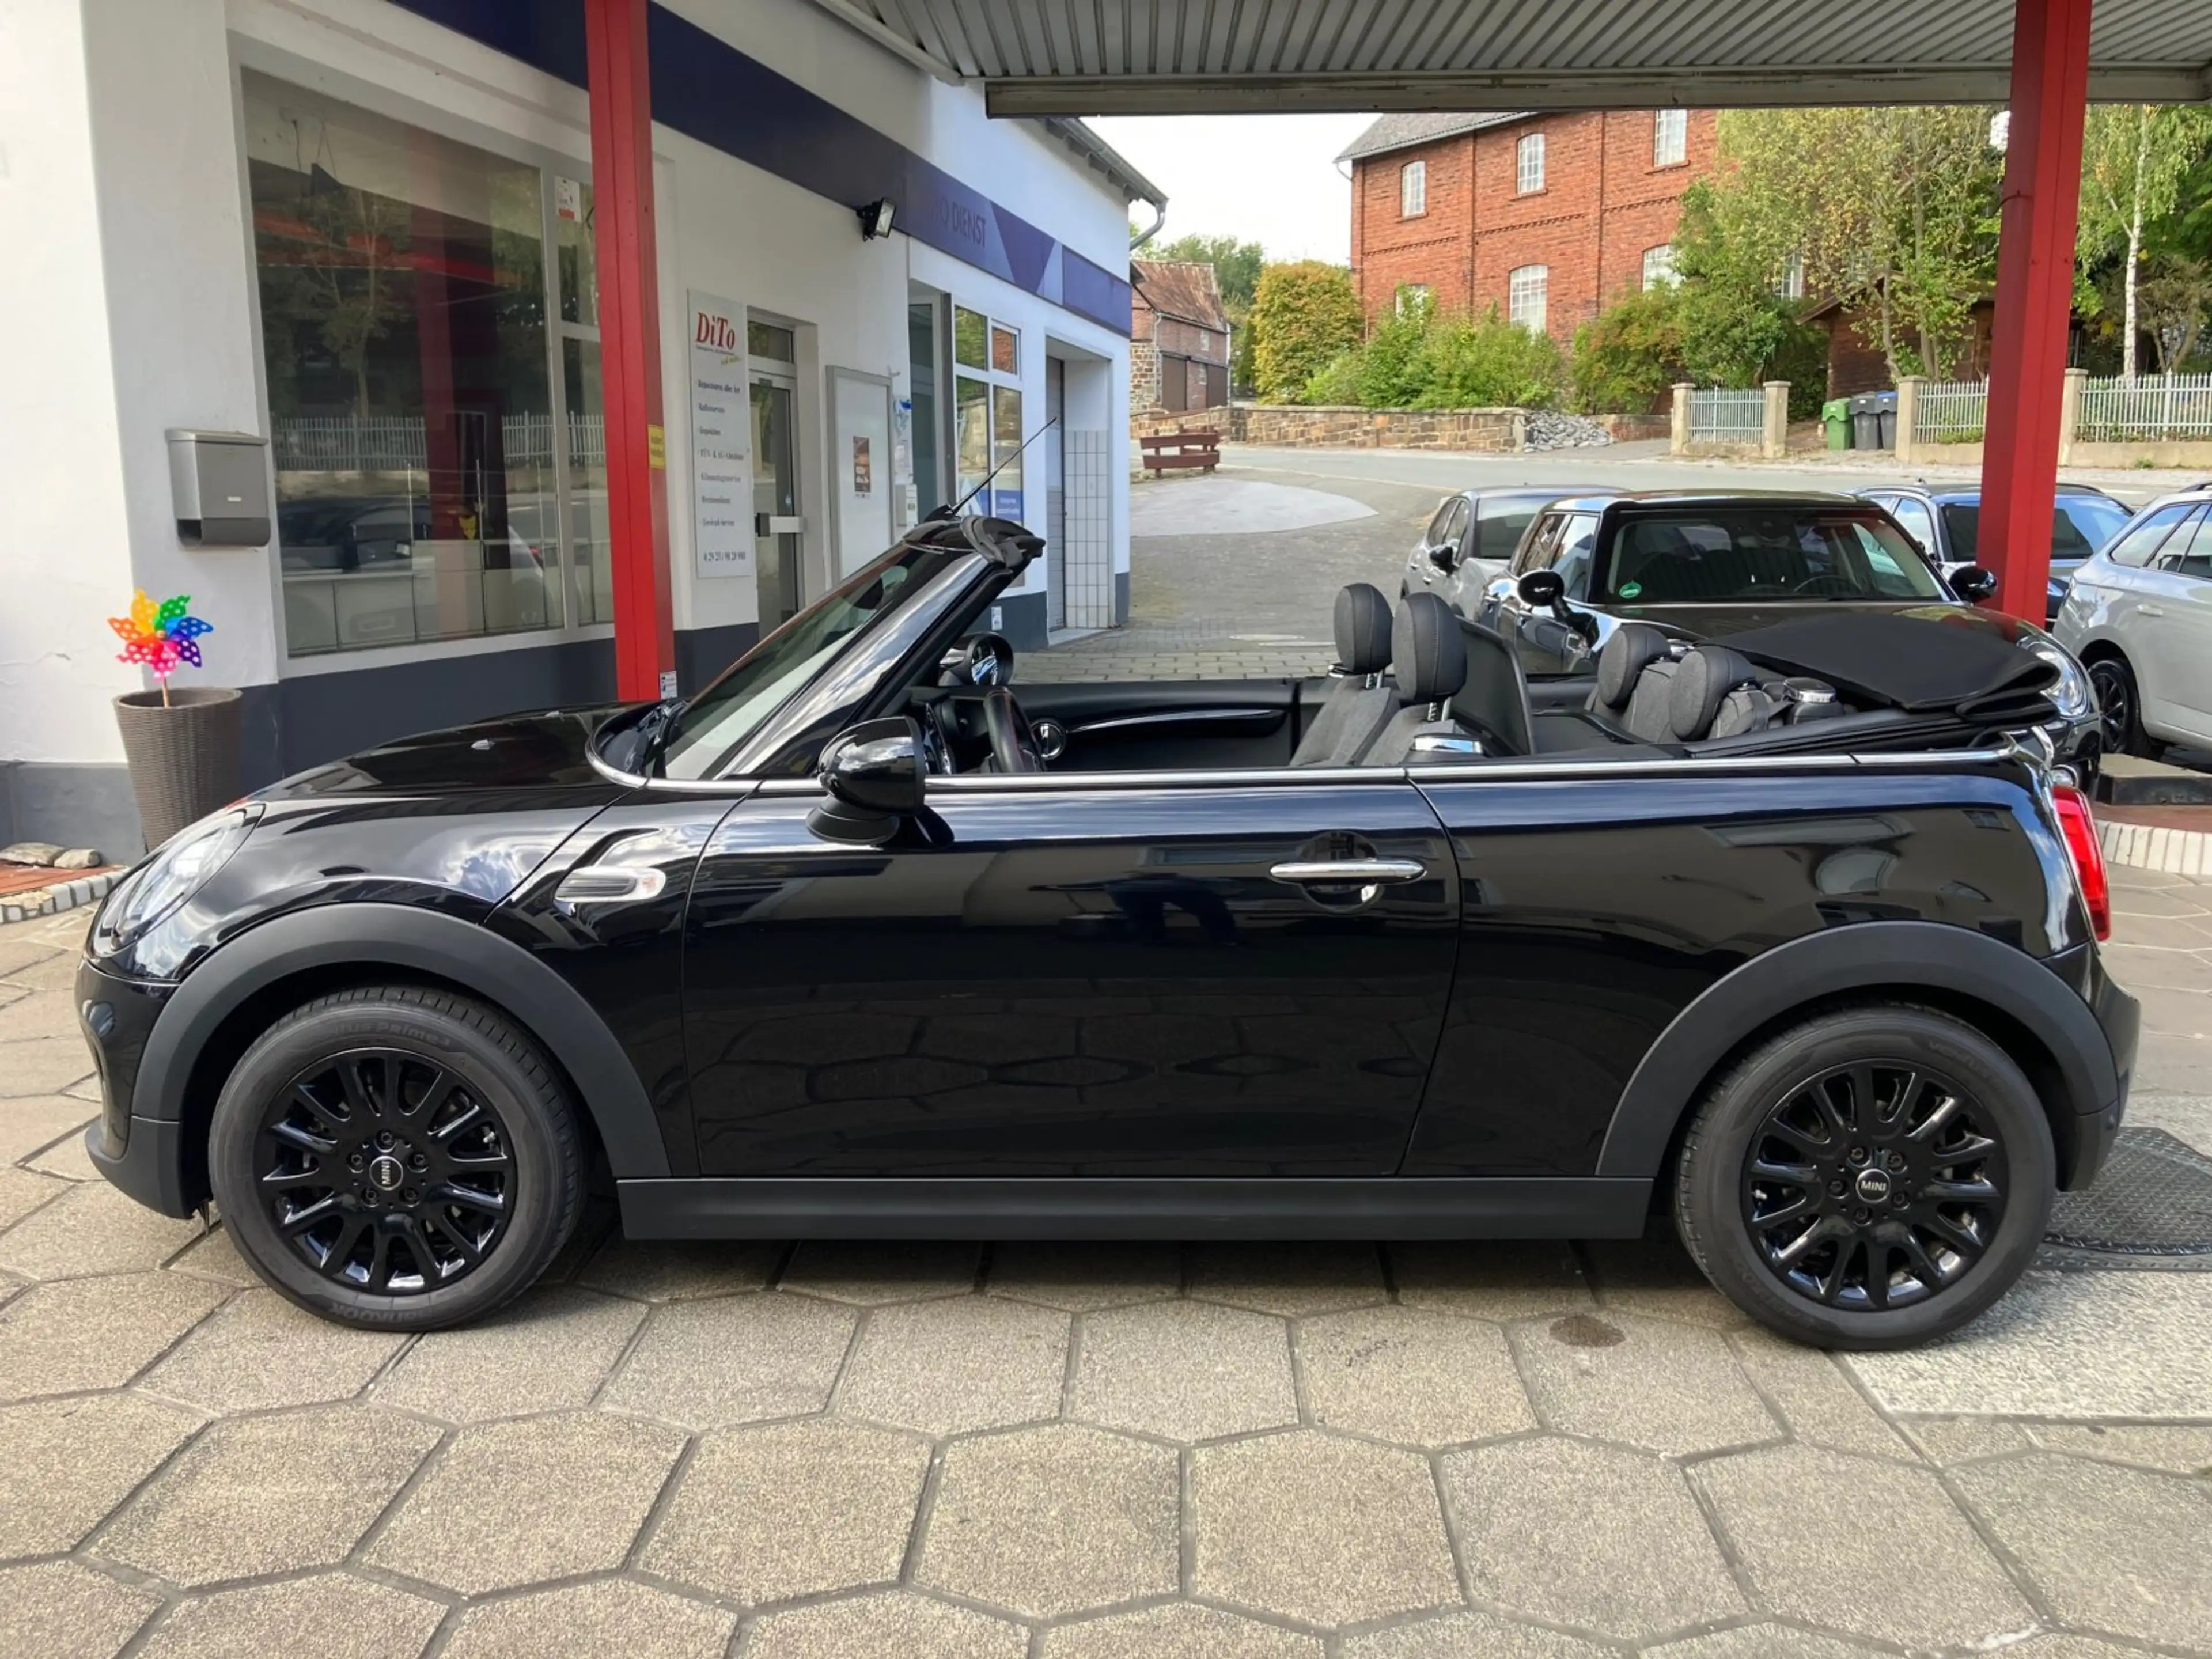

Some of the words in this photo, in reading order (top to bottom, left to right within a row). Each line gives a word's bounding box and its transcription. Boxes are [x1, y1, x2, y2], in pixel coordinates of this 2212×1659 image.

[952, 202, 987, 248] DIENST
[695, 311, 735, 350] DiTo
[381, 1161, 391, 1185] MINI
[1860, 1180, 1887, 1192] MINI
